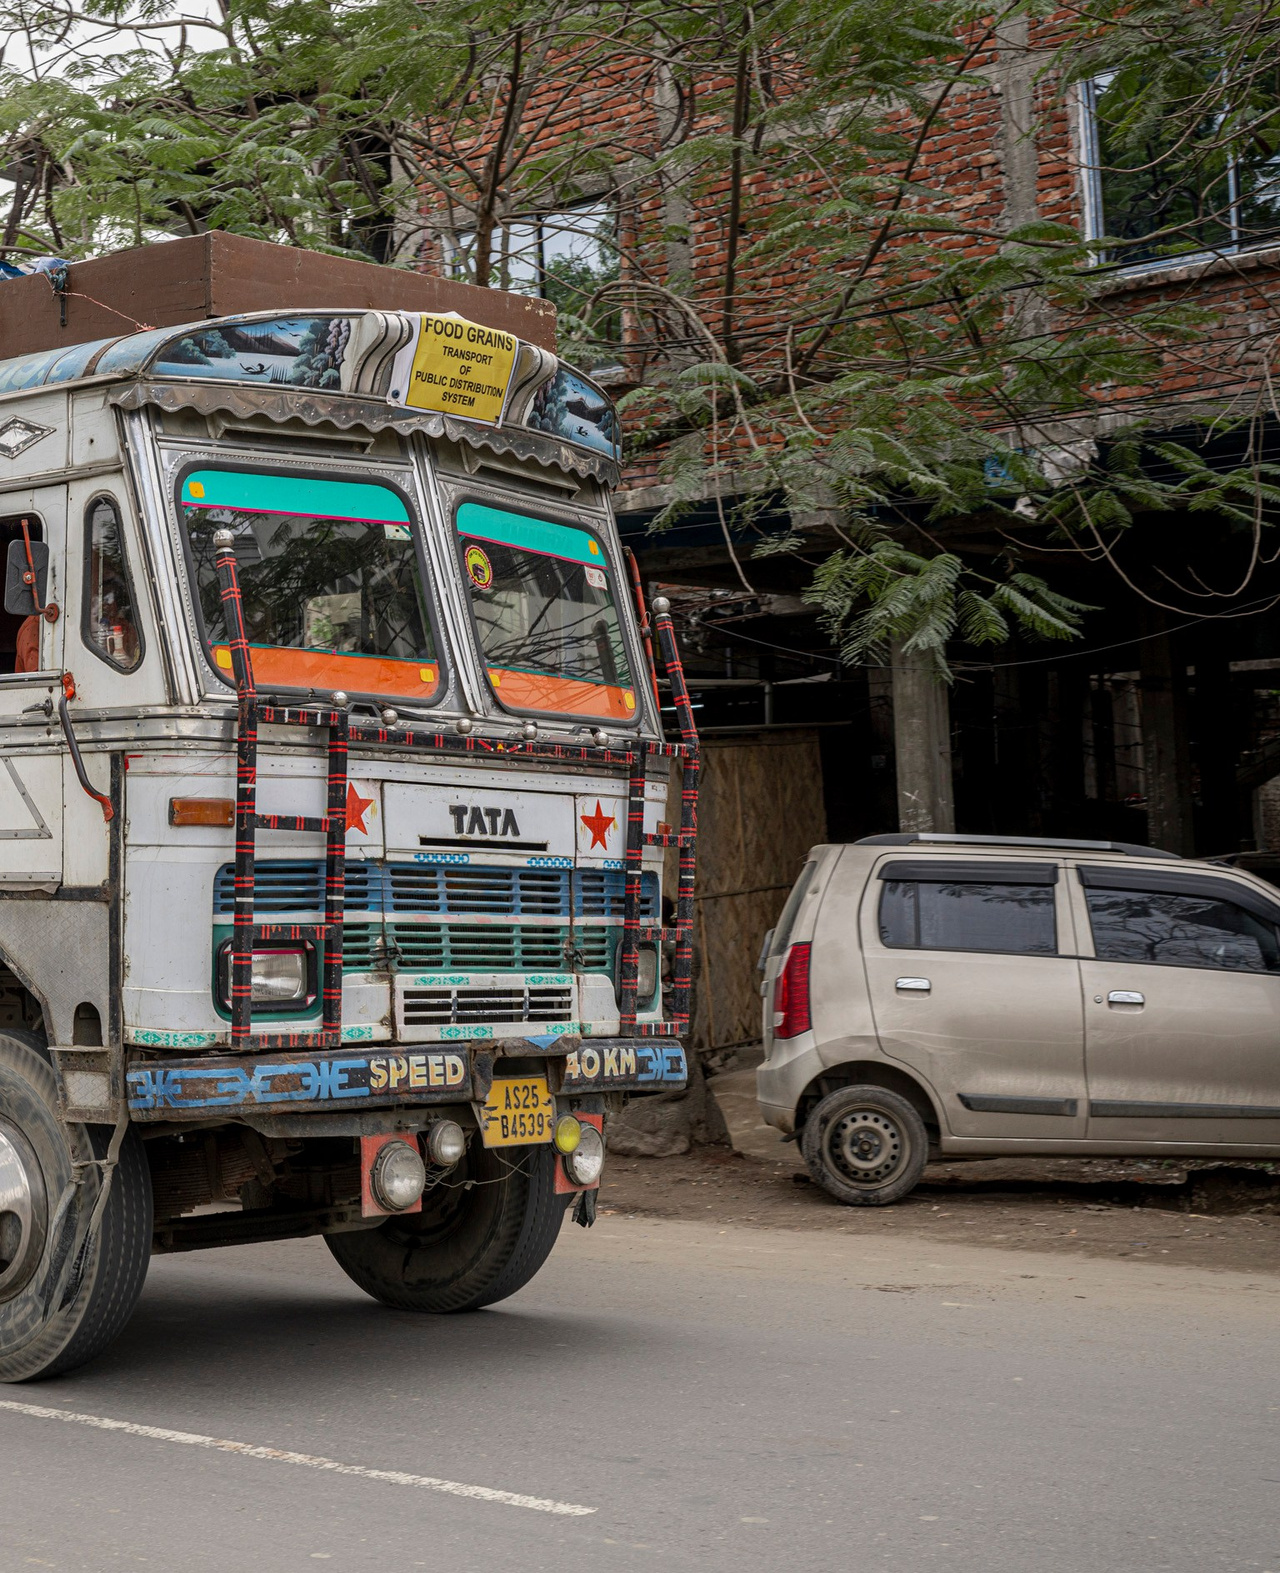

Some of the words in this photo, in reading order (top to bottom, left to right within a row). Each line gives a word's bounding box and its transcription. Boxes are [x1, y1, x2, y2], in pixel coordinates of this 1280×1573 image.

[424, 317, 463, 340] FOOD
[467, 327, 513, 352] GRAINS
[442, 345, 493, 366] TRANSPORT
[459, 365, 472, 376] OF
[415, 371, 447, 386] PUBLIC
[449, 378, 503, 398] DISTRIBUTION
[441, 391, 475, 407] SYSTEM
[448, 804, 521, 837] TATA
[369, 1054, 465, 1088] SPEED
[566, 1048, 600, 1080] 40
[603, 1047, 636, 1077] KM
[504, 1085, 539, 1110] AS25
[501, 1112, 545, 1139] B4539
